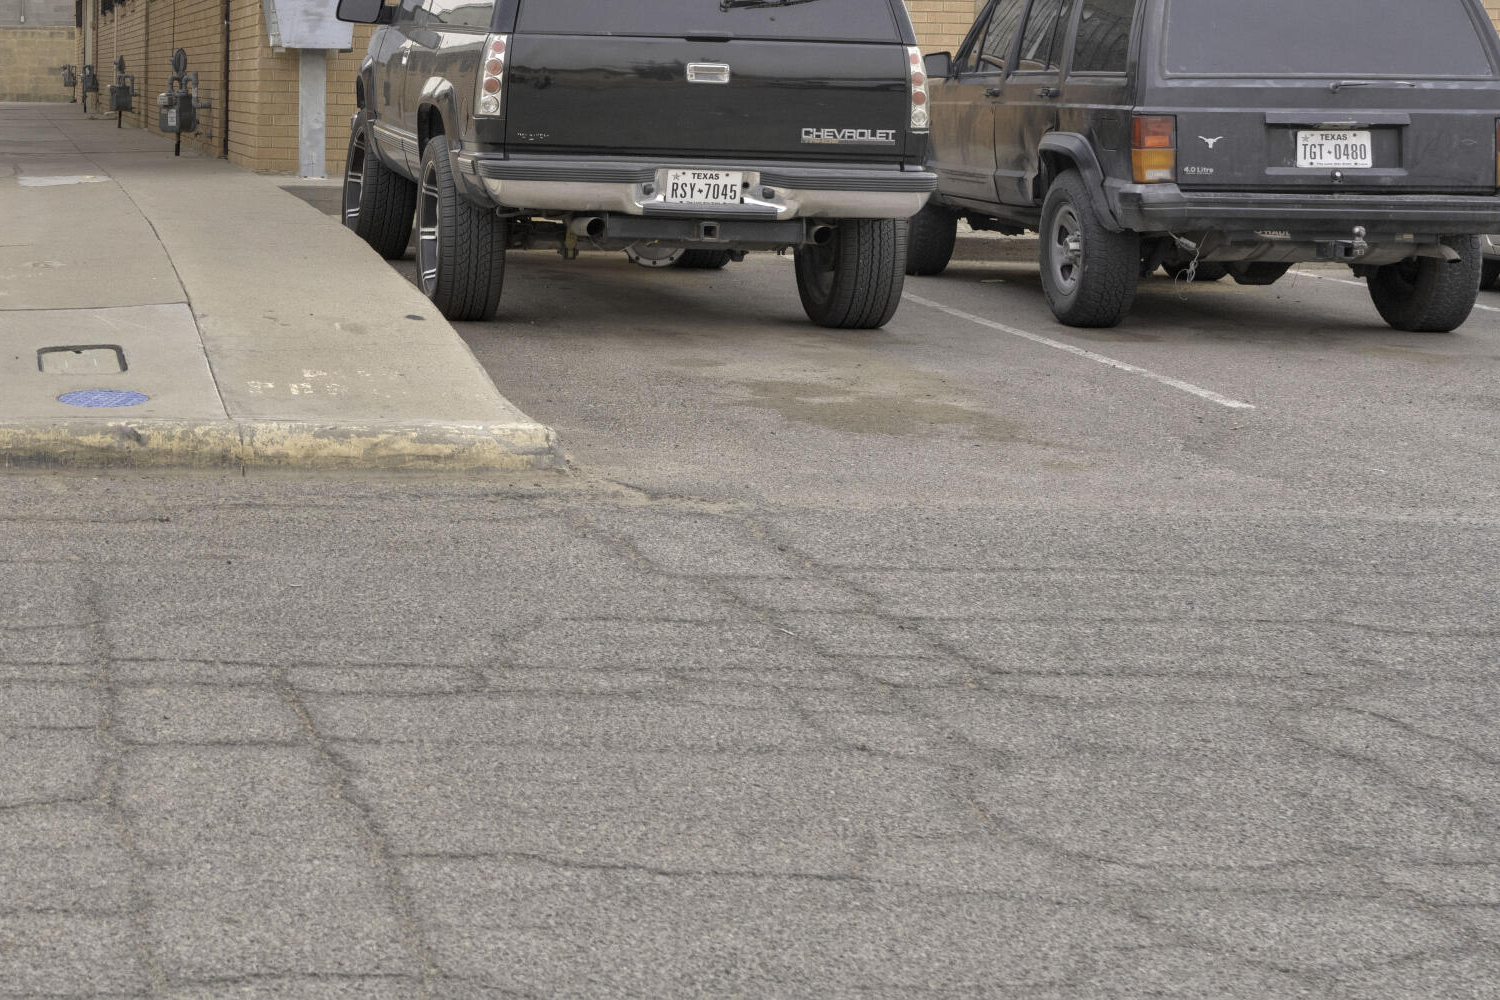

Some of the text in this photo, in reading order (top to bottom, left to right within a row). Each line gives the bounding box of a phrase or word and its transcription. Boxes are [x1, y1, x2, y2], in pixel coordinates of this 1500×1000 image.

[802, 127, 896, 141] CHEVROLET
[1320, 133, 1348, 141] TEXAS
[1302, 143, 1367, 160] TGT 0480
[691, 172, 720, 180] TEXAS
[671, 182, 737, 200] RSY 7045
